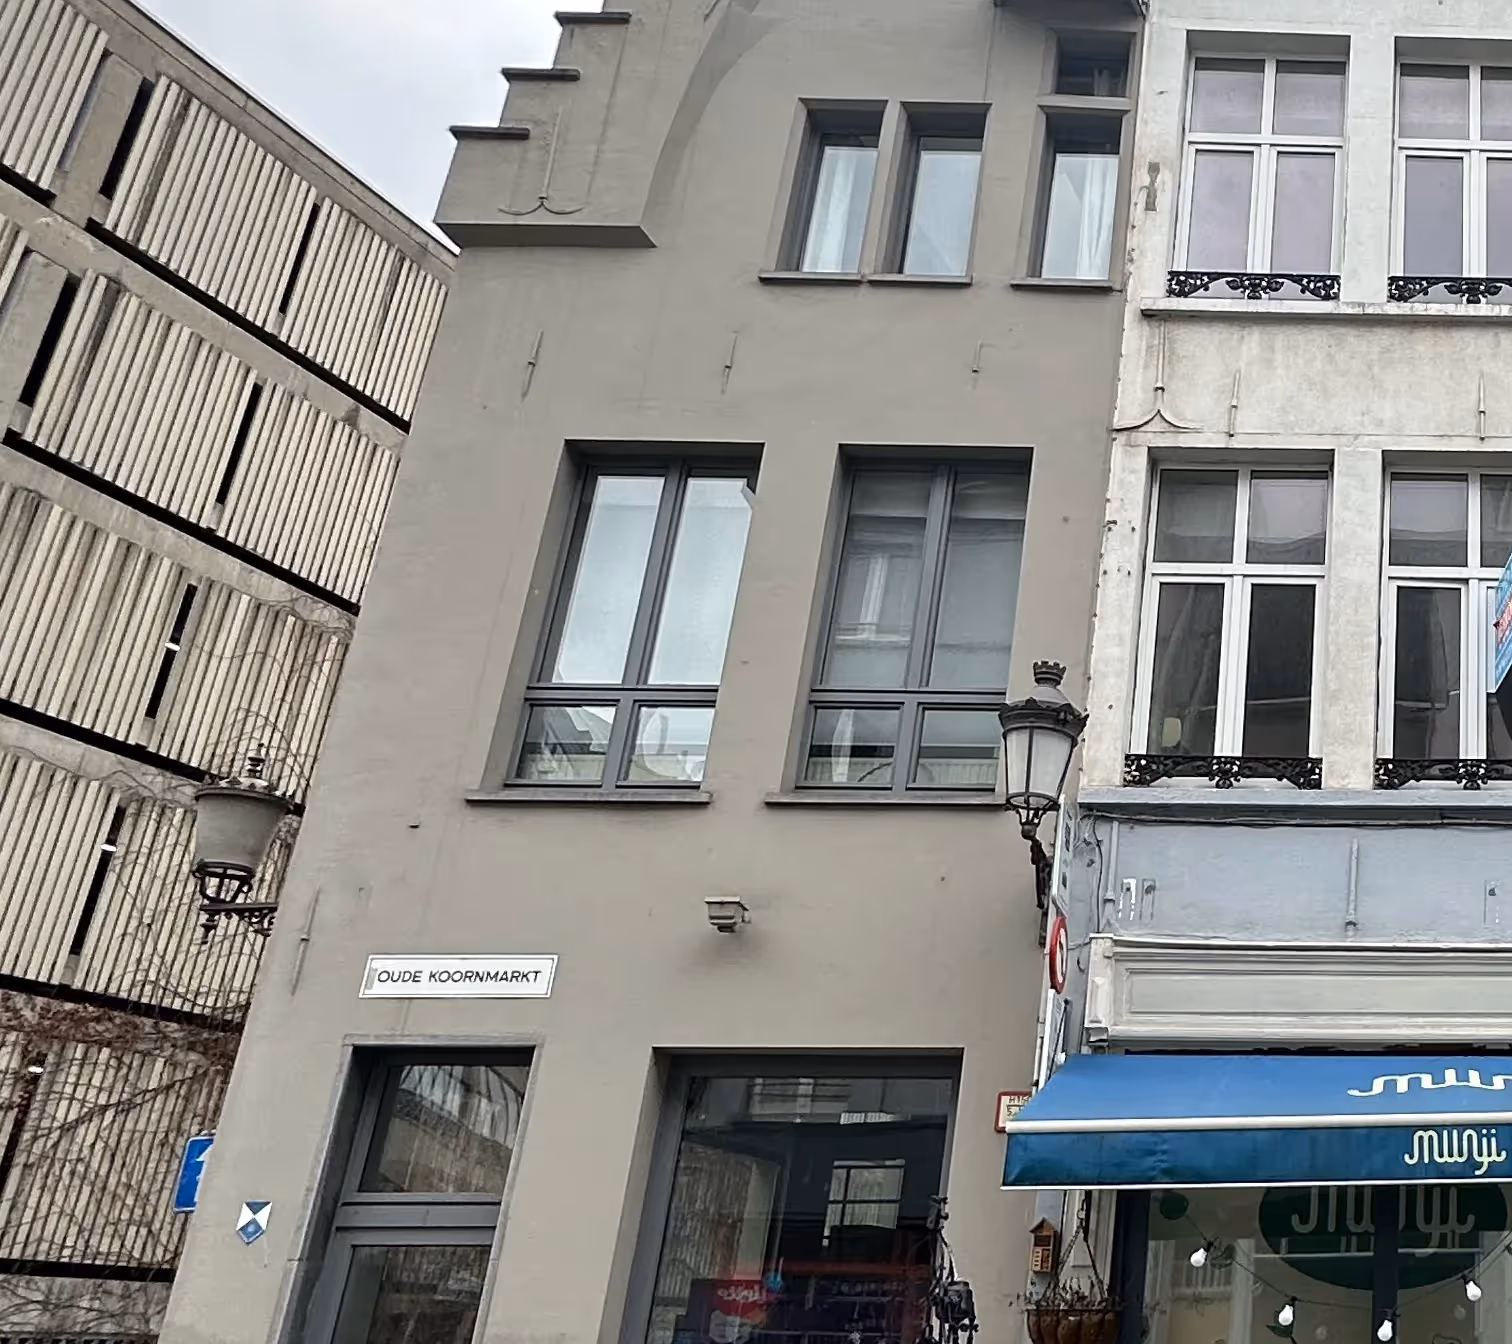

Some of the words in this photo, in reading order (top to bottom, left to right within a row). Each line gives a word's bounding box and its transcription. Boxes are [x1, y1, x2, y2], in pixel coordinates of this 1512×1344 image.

[377, 970, 423, 983] OUDE
[428, 970, 542, 983] KOORNMARKT
[1404, 1128, 1507, 1176] munji
